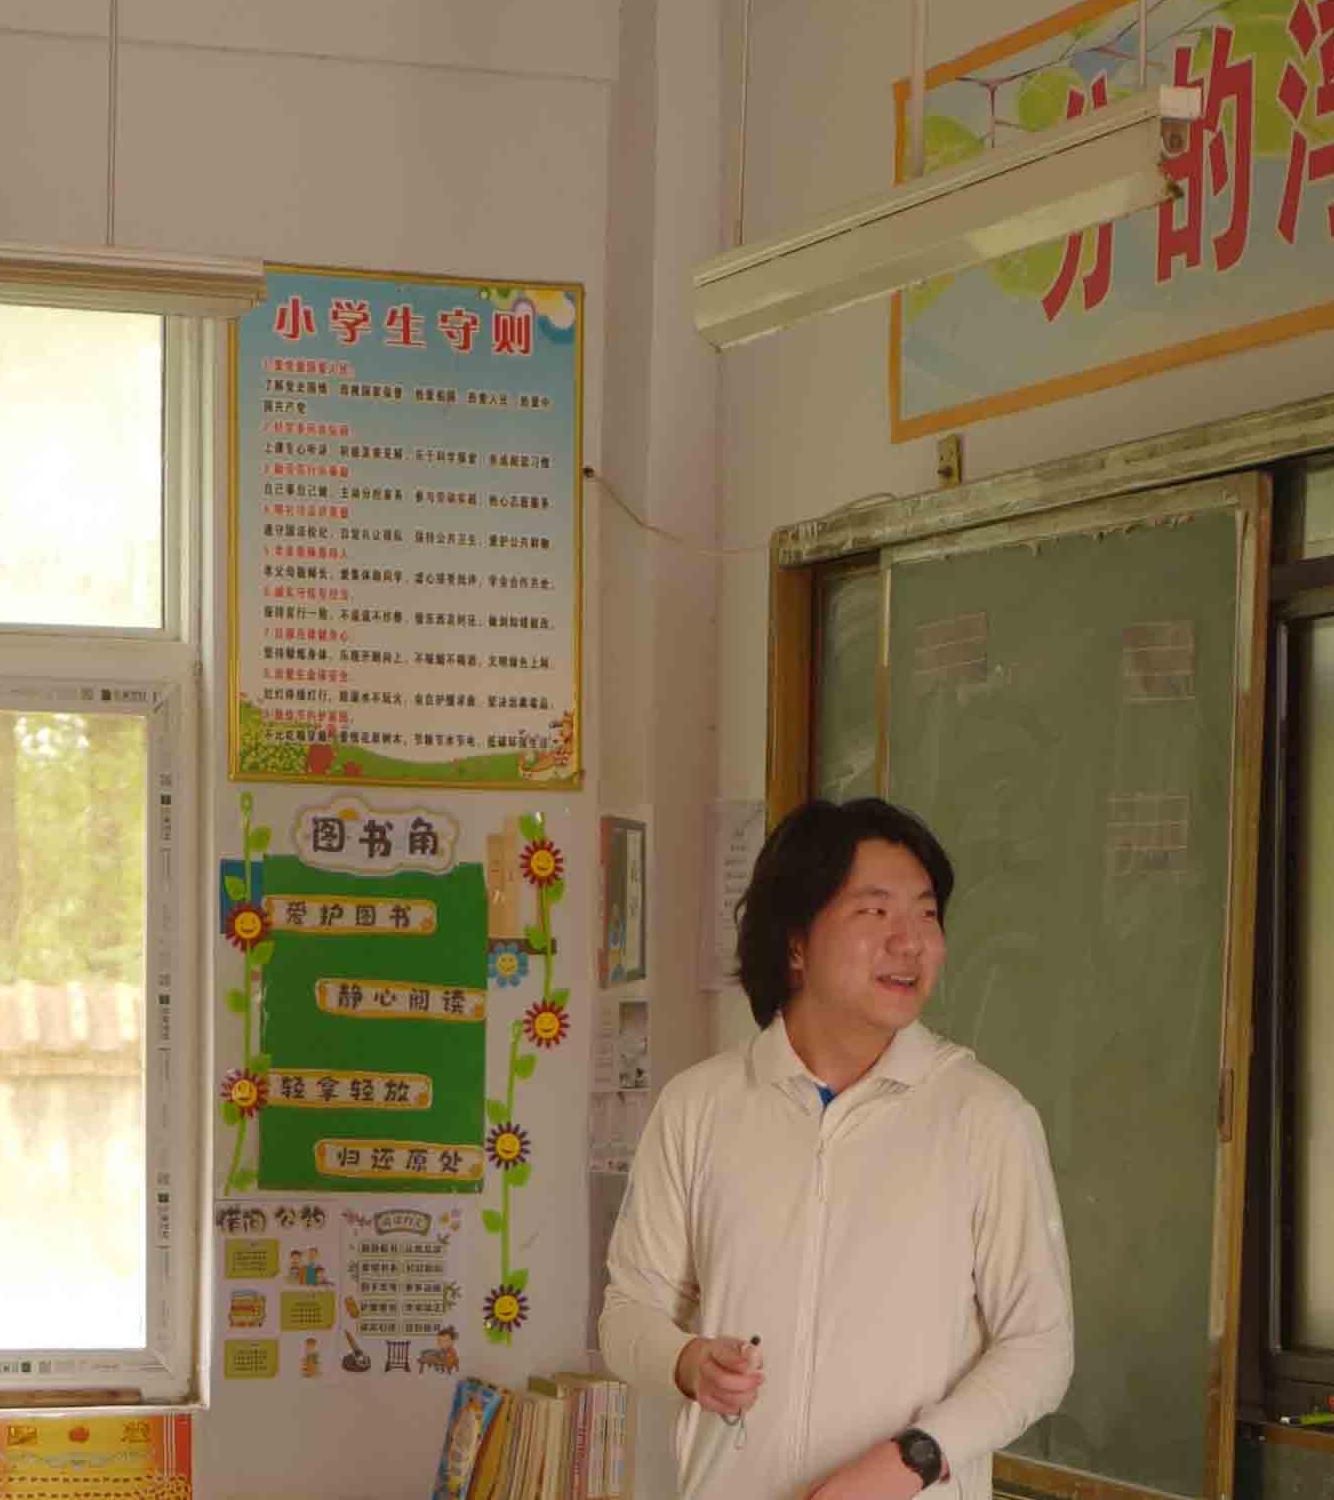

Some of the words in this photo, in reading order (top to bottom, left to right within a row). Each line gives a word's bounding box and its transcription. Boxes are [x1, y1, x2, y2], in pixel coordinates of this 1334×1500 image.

[275, 297, 532, 355] 小学生守则
[311, 815, 441, 858] 图书角
[285, 901, 412, 928] 爱护图书
[337, 983, 466, 1013] 静心阅读
[280, 1074, 411, 1102] 轻拿轻放
[336, 1147, 464, 1173] 归还原处
